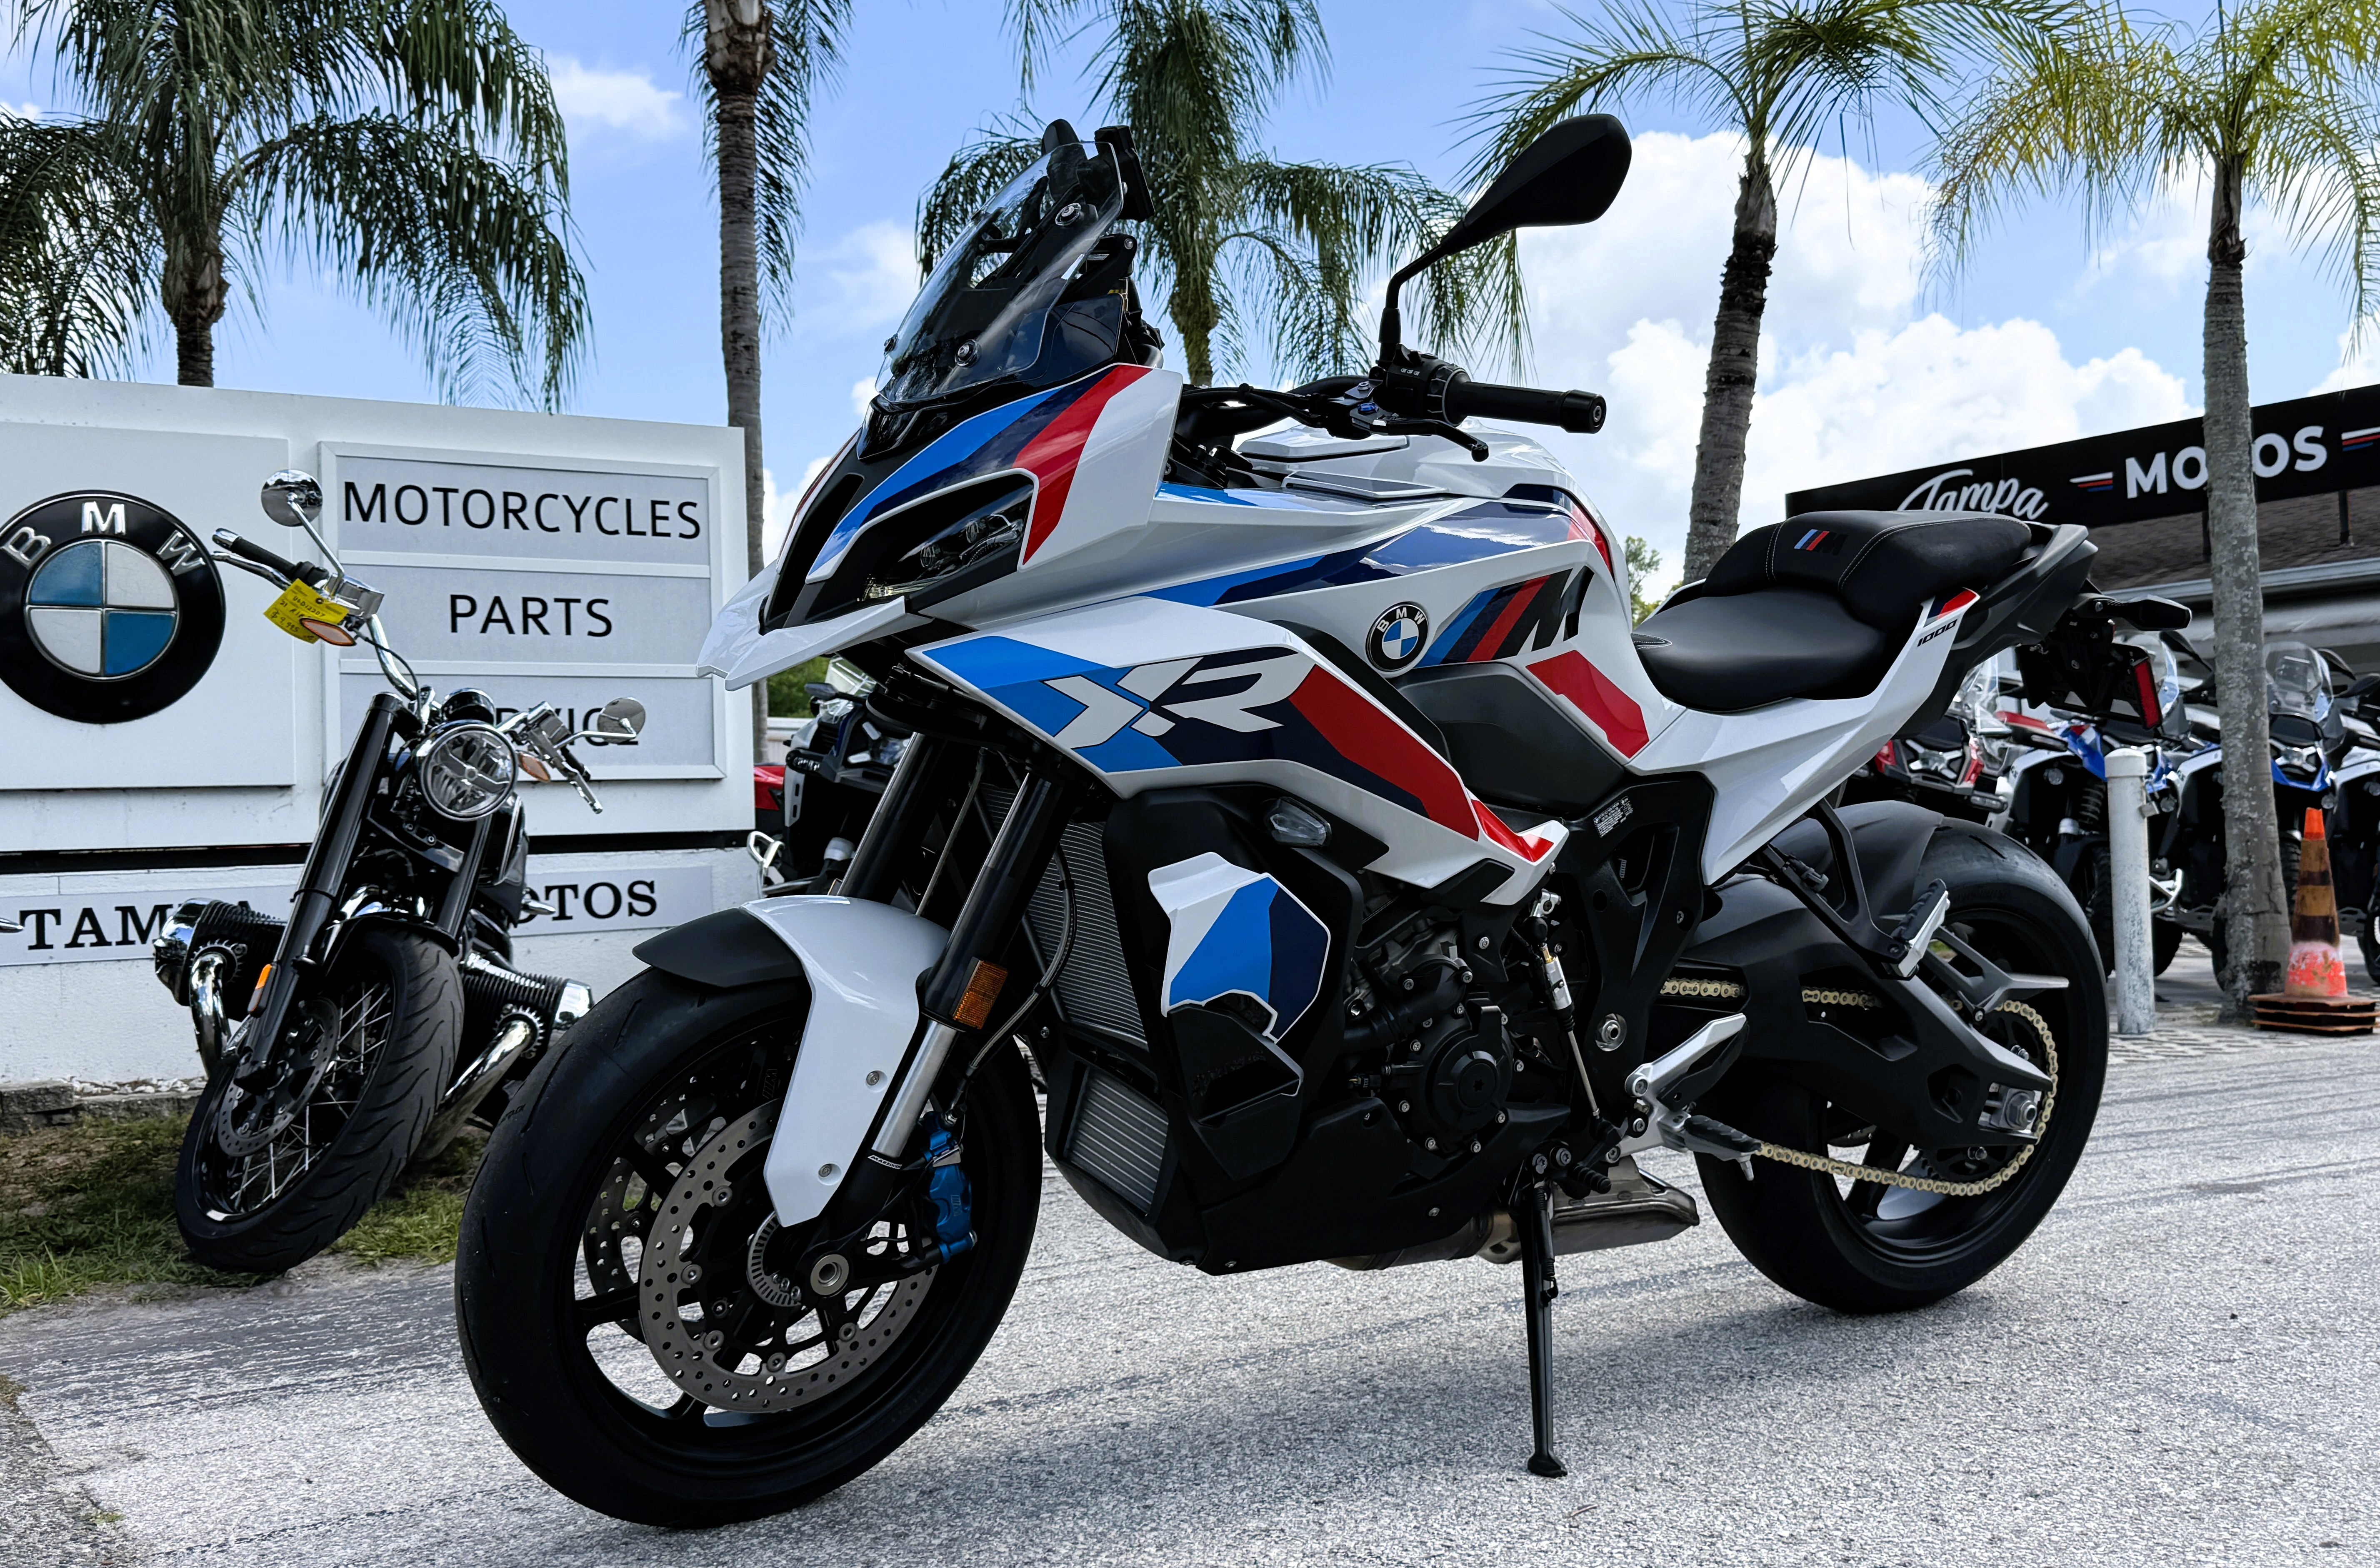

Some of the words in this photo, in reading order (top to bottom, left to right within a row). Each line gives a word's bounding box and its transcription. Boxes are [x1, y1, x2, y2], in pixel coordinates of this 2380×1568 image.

[2125, 425, 2327, 499] MOOS
[344, 481, 700, 539] MOTORCYCLES
[1897, 468, 2049, 520] Tampa
[1, 501, 206, 576] BMW
[450, 594, 612, 637] PARTS
[1376, 607, 1425, 632] BMW
[1917, 619, 1958, 647] 1000
[1042, 652, 1316, 749] XR
[20, 900, 250, 950] TAM
[517, 880, 657, 924] TOS
